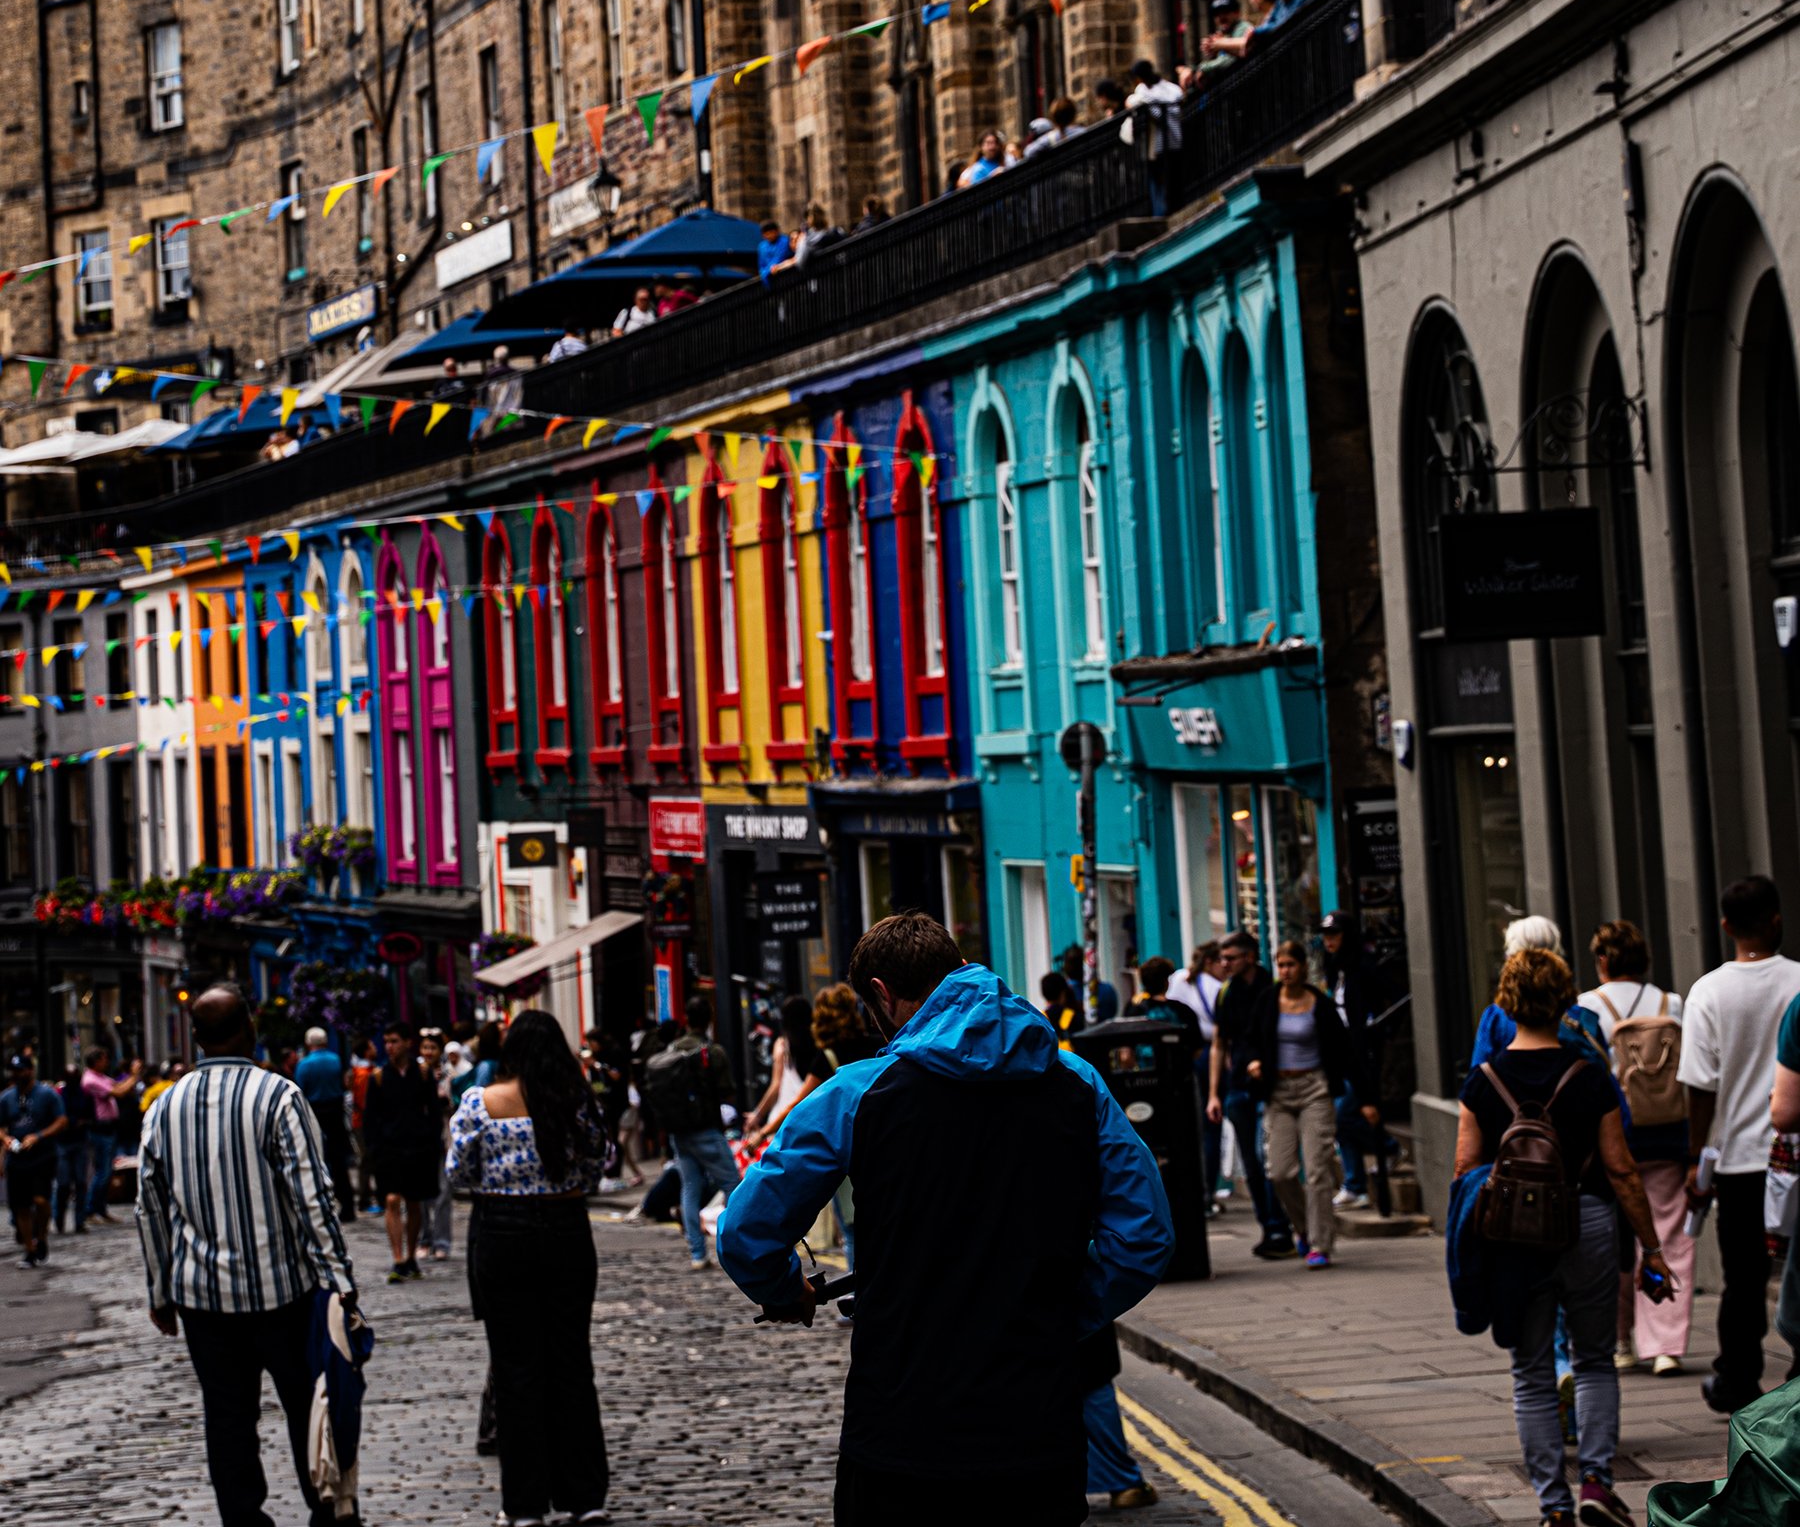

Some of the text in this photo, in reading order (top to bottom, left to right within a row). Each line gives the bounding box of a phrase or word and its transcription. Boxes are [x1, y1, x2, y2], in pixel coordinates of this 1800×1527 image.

[725, 815, 745, 838] THE
[746, 816, 780, 839] WHISKY
[781, 816, 808, 840] SHOP
[775, 883, 802, 895] THE
[762, 901, 817, 914] WHISKY
[772, 921, 809, 933] SHOP
